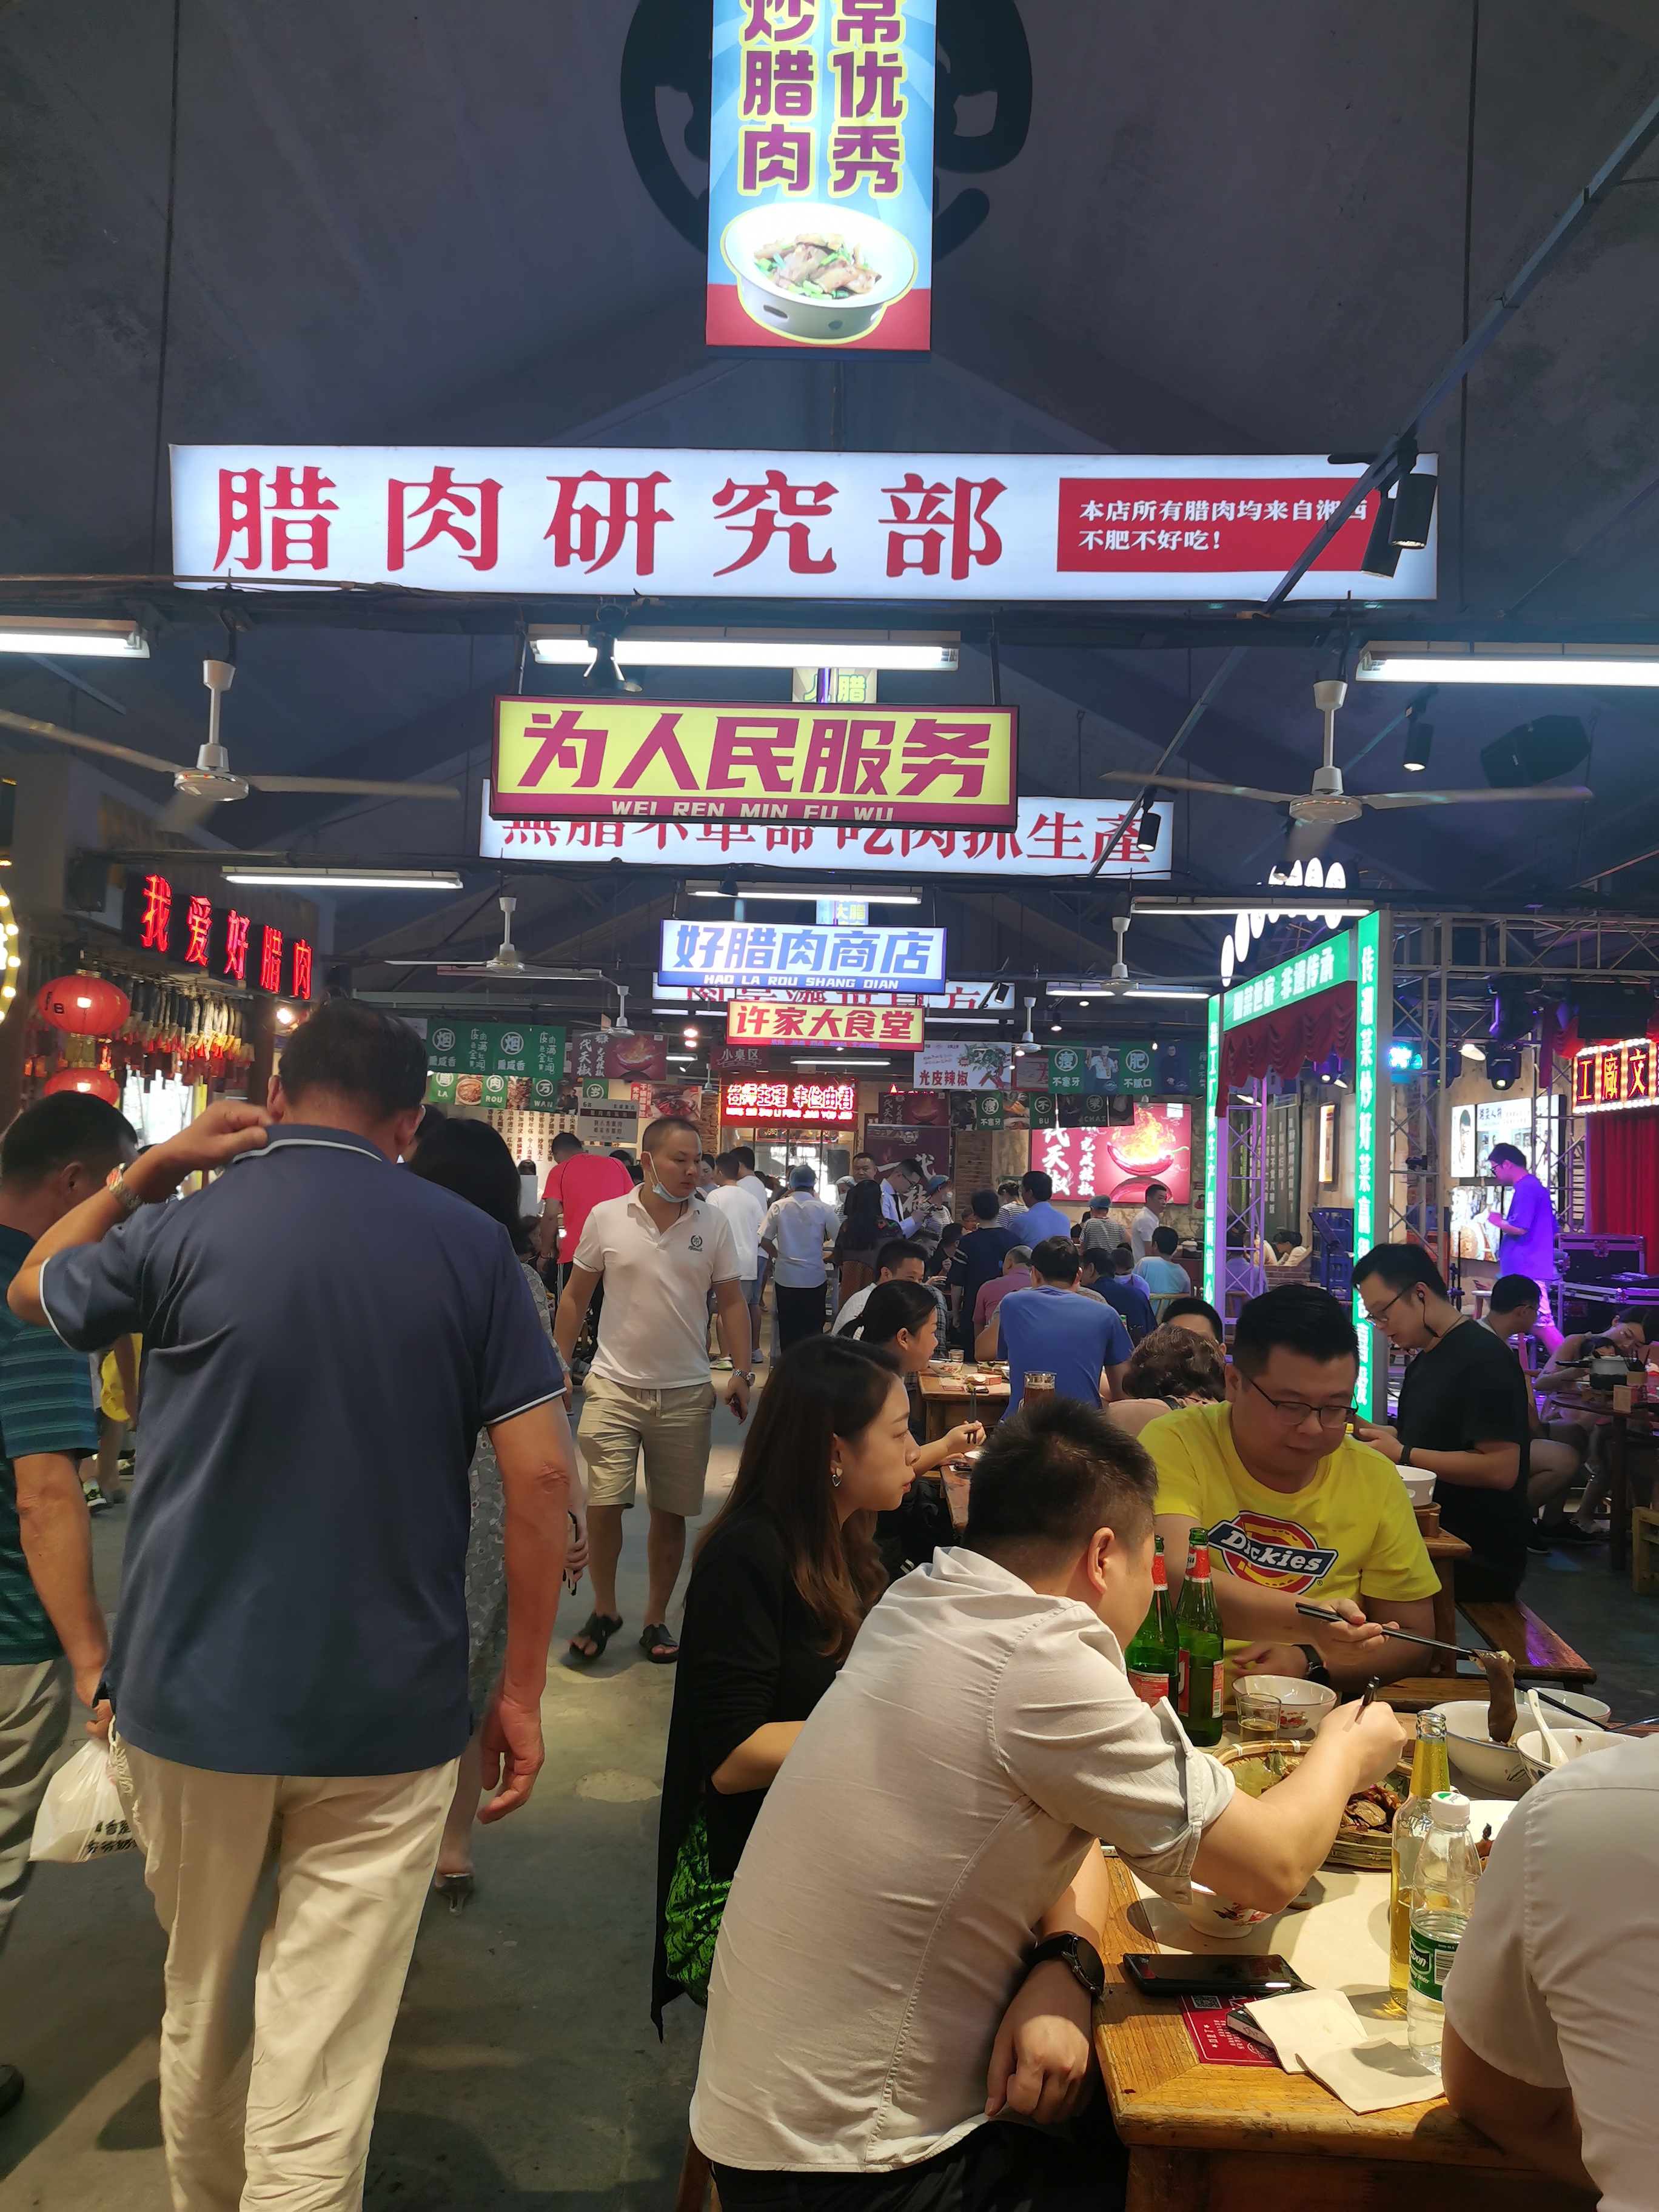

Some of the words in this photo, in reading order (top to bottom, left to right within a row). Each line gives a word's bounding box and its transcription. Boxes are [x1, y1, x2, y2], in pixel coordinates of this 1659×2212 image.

[212, 464, 1007, 580] 腊肉研究部
[517, 710, 991, 797] 为人民服务
[612, 800, 657, 816] WEI
[672, 802, 725, 817] REN
[740, 803, 788, 819] MIN
[803, 805, 839, 820] FU
[854, 806, 894, 822] WU
[141, 874, 312, 1000] 我爱好腊肉
[672, 925, 933, 974] 好腊肉商店
[703, 974, 734, 985] HAO
[742, 976, 761, 985] LA
[768, 977, 798, 987] ROU
[806, 977, 856, 988] SHANG
[863, 979, 899, 989] DIAN
[737, 1005, 914, 1039] 许家大食堂
[919, 1070, 968, 1087] 光皮辣椒
[1578, 1048, 1659, 1101] 工廠文
[1221, 1530, 1323, 1572] Dickies
